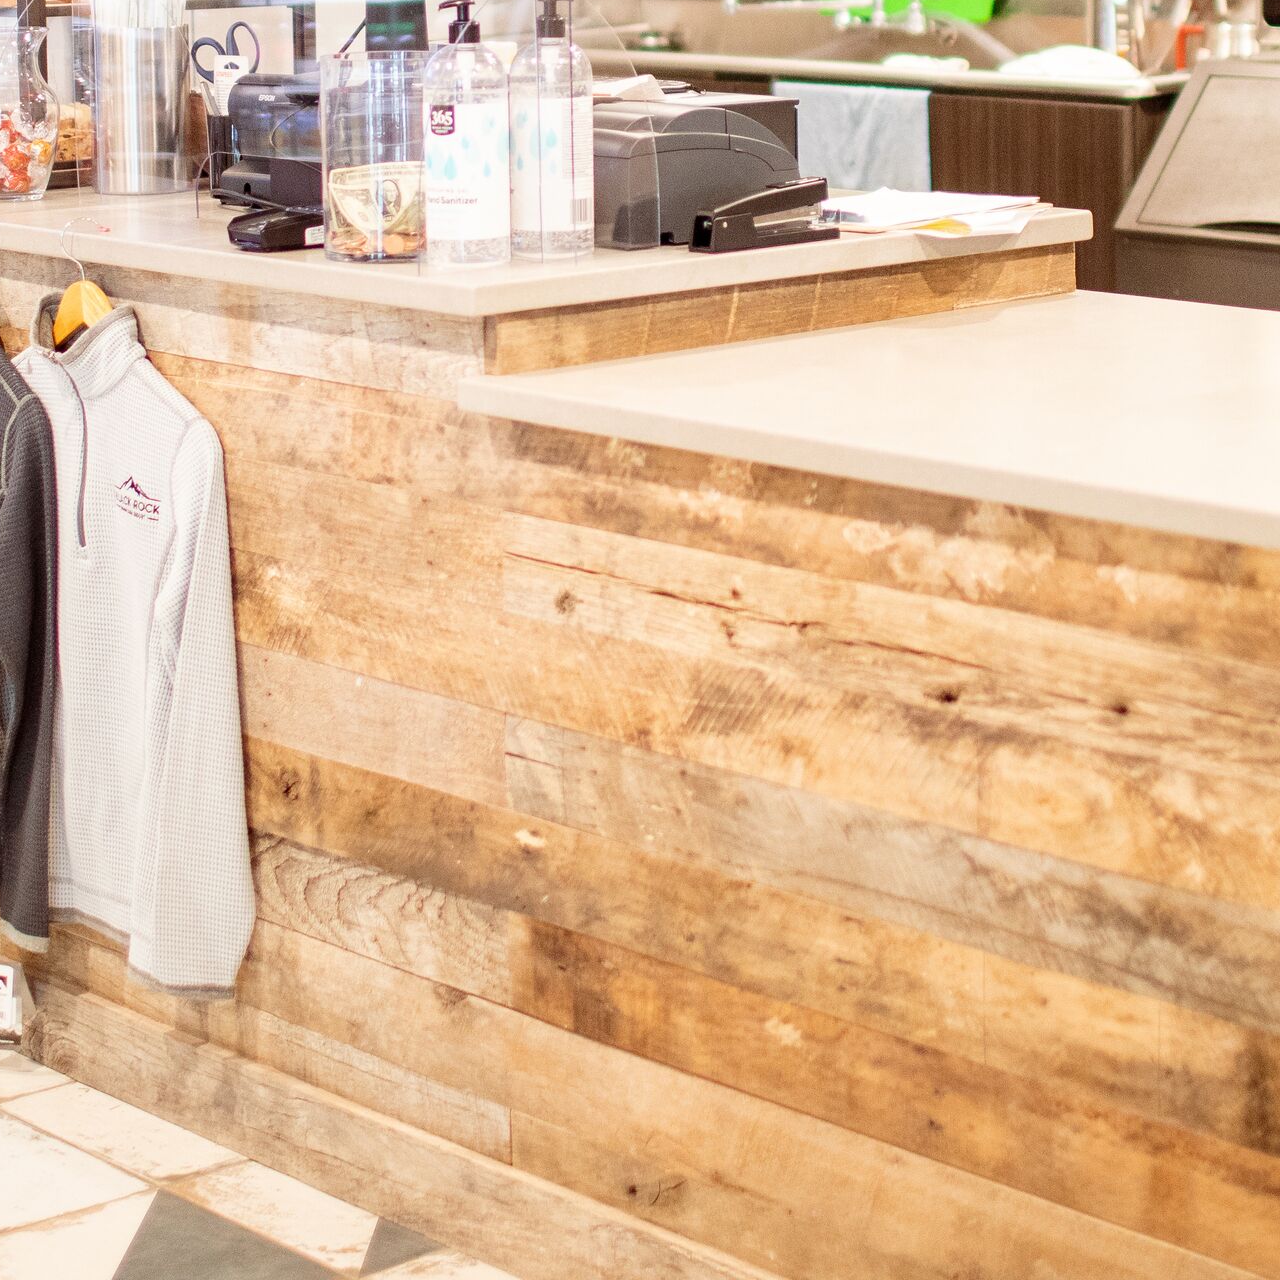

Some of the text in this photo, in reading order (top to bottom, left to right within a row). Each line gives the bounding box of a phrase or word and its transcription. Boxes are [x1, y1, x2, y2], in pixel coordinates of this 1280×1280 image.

[258, 94, 276, 102] EPSON
[431, 109, 454, 126] 365
[441, 196, 478, 205] Sanitizer
[133, 499, 160, 514] ROCK
